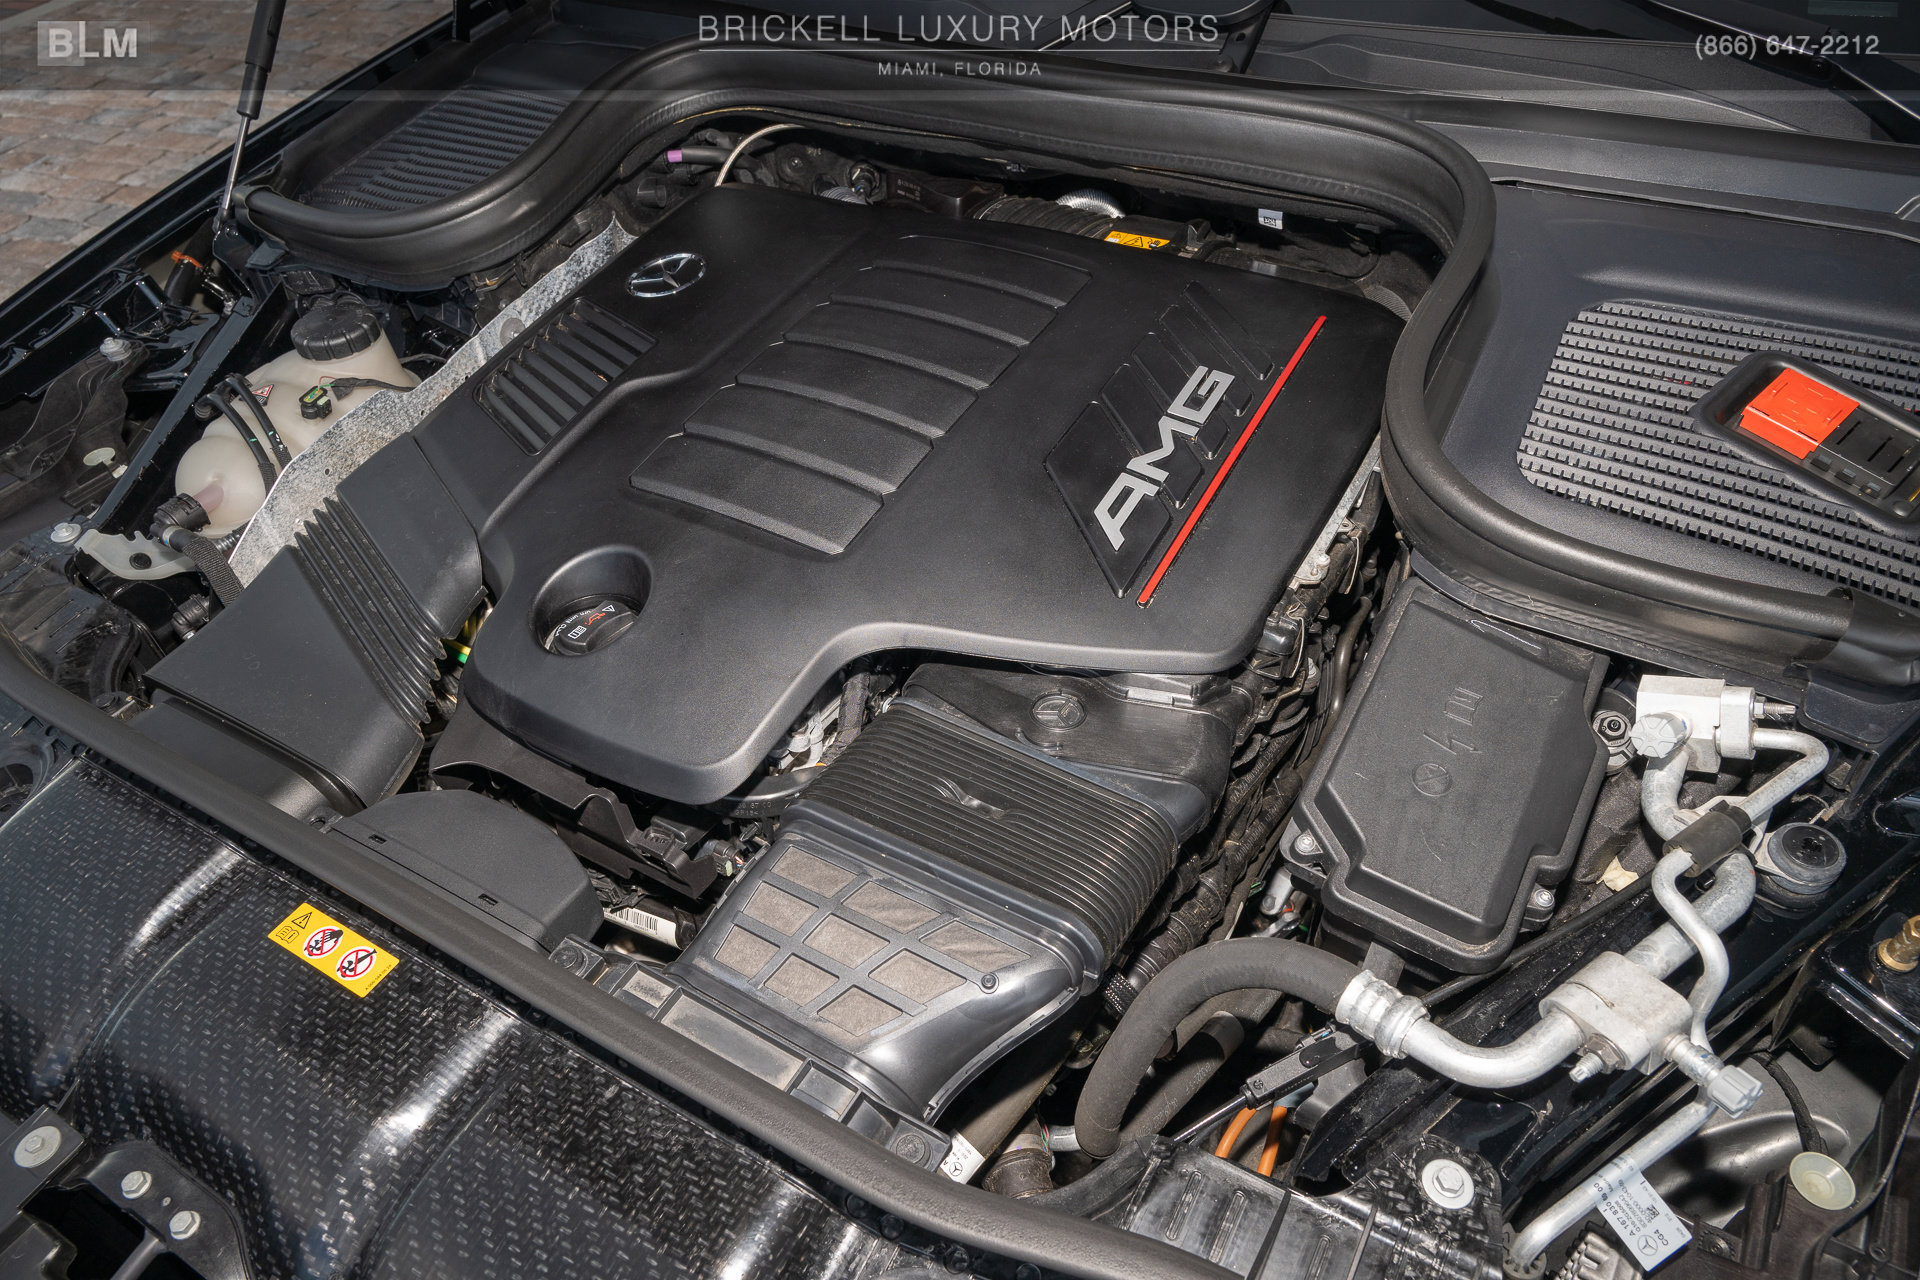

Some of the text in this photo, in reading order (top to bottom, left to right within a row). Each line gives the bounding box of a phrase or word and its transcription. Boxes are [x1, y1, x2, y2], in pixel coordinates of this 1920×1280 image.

[1094, 365, 1235, 551] AMG
[1605, 1201, 1619, 1216] 830
[1617, 1216, 1630, 1230] 167
[1654, 1229, 1669, 1246] CG4
